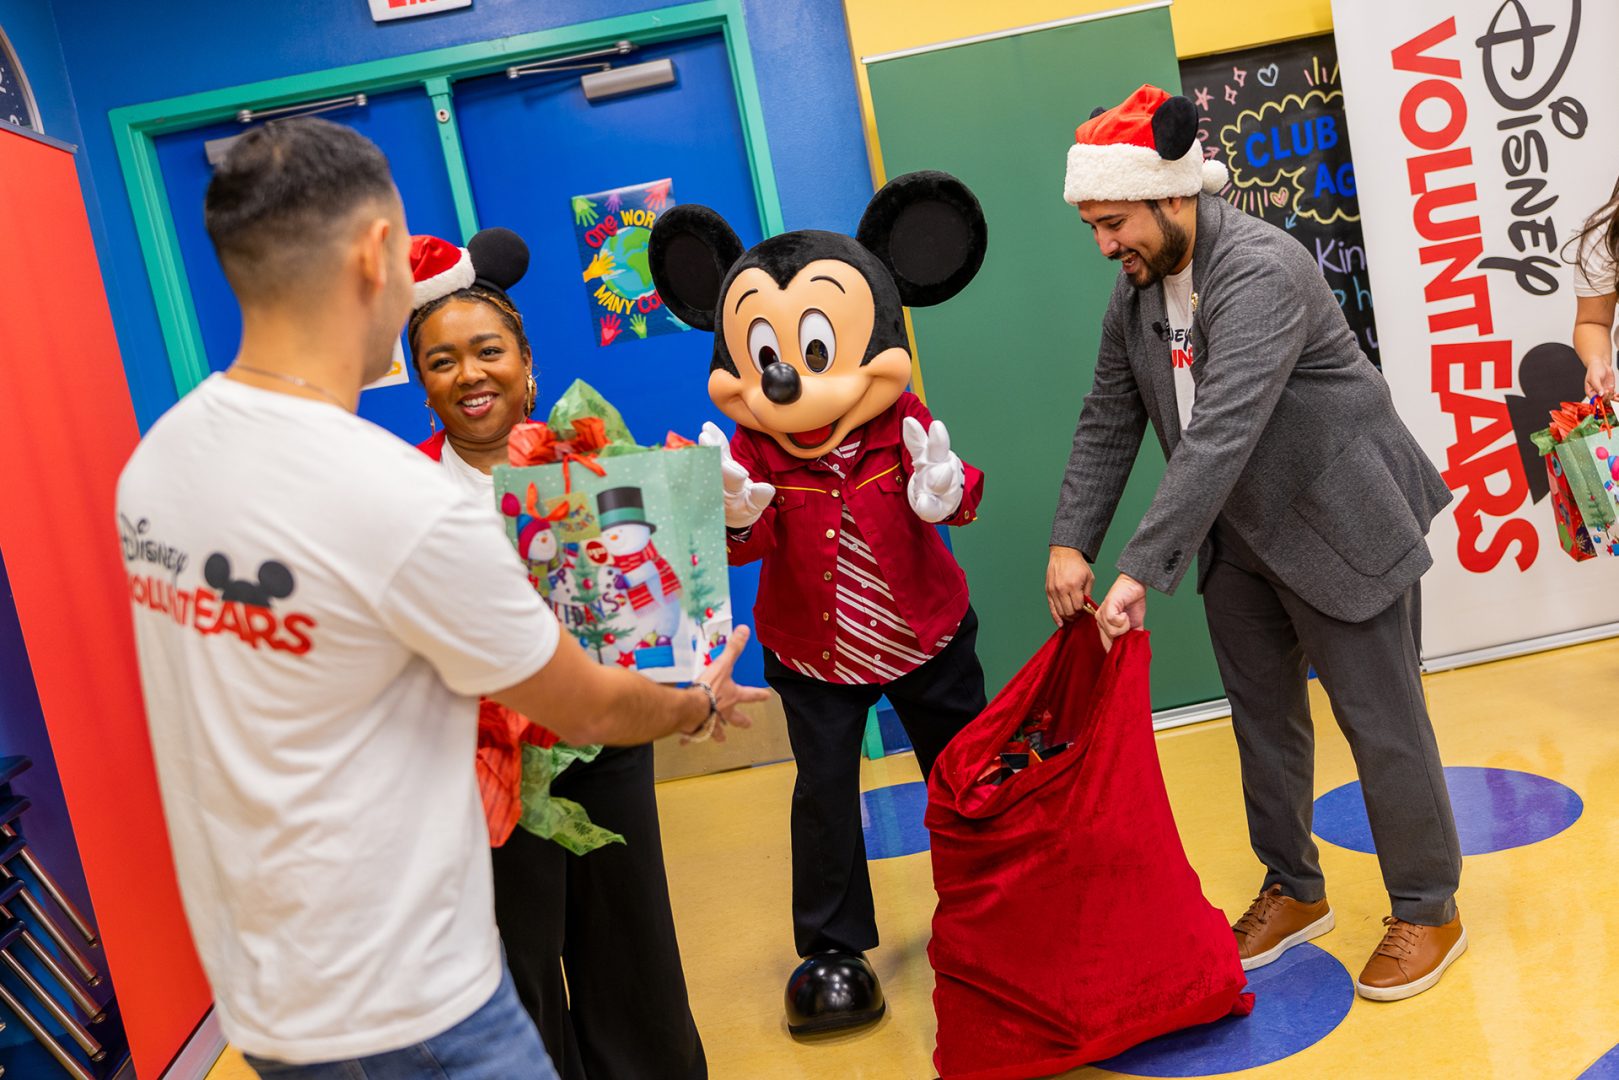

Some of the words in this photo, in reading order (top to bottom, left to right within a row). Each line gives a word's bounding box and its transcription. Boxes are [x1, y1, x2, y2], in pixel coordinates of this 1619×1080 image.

[1244, 115, 1340, 169] CLUB
[1475, 0, 1588, 296] Disney
[593, 284, 636, 315] MANY
[1389, 15, 1539, 574] VOLUNTEARS
[129, 574, 317, 656] OLUNTEARS
